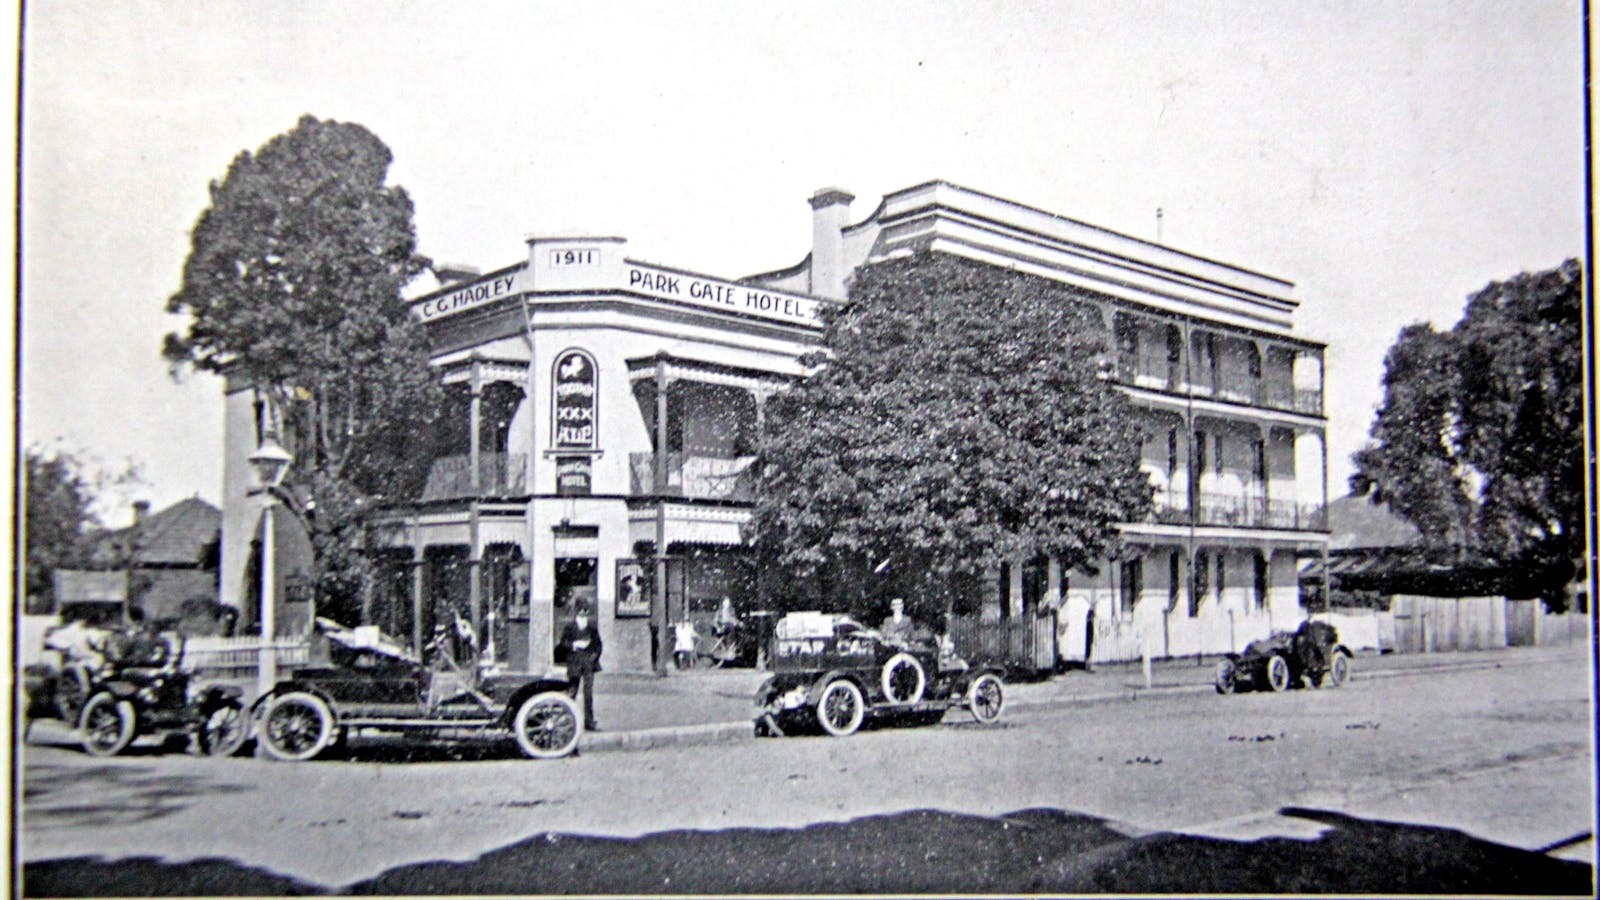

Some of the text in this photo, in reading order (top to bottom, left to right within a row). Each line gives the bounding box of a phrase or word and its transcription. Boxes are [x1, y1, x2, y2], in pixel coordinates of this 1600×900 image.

[556, 251, 592, 265] 1911
[453, 276, 515, 309] HADLEY
[629, 269, 805, 318] PARK GATE HOTEL
[557, 406, 593, 420] XXX
